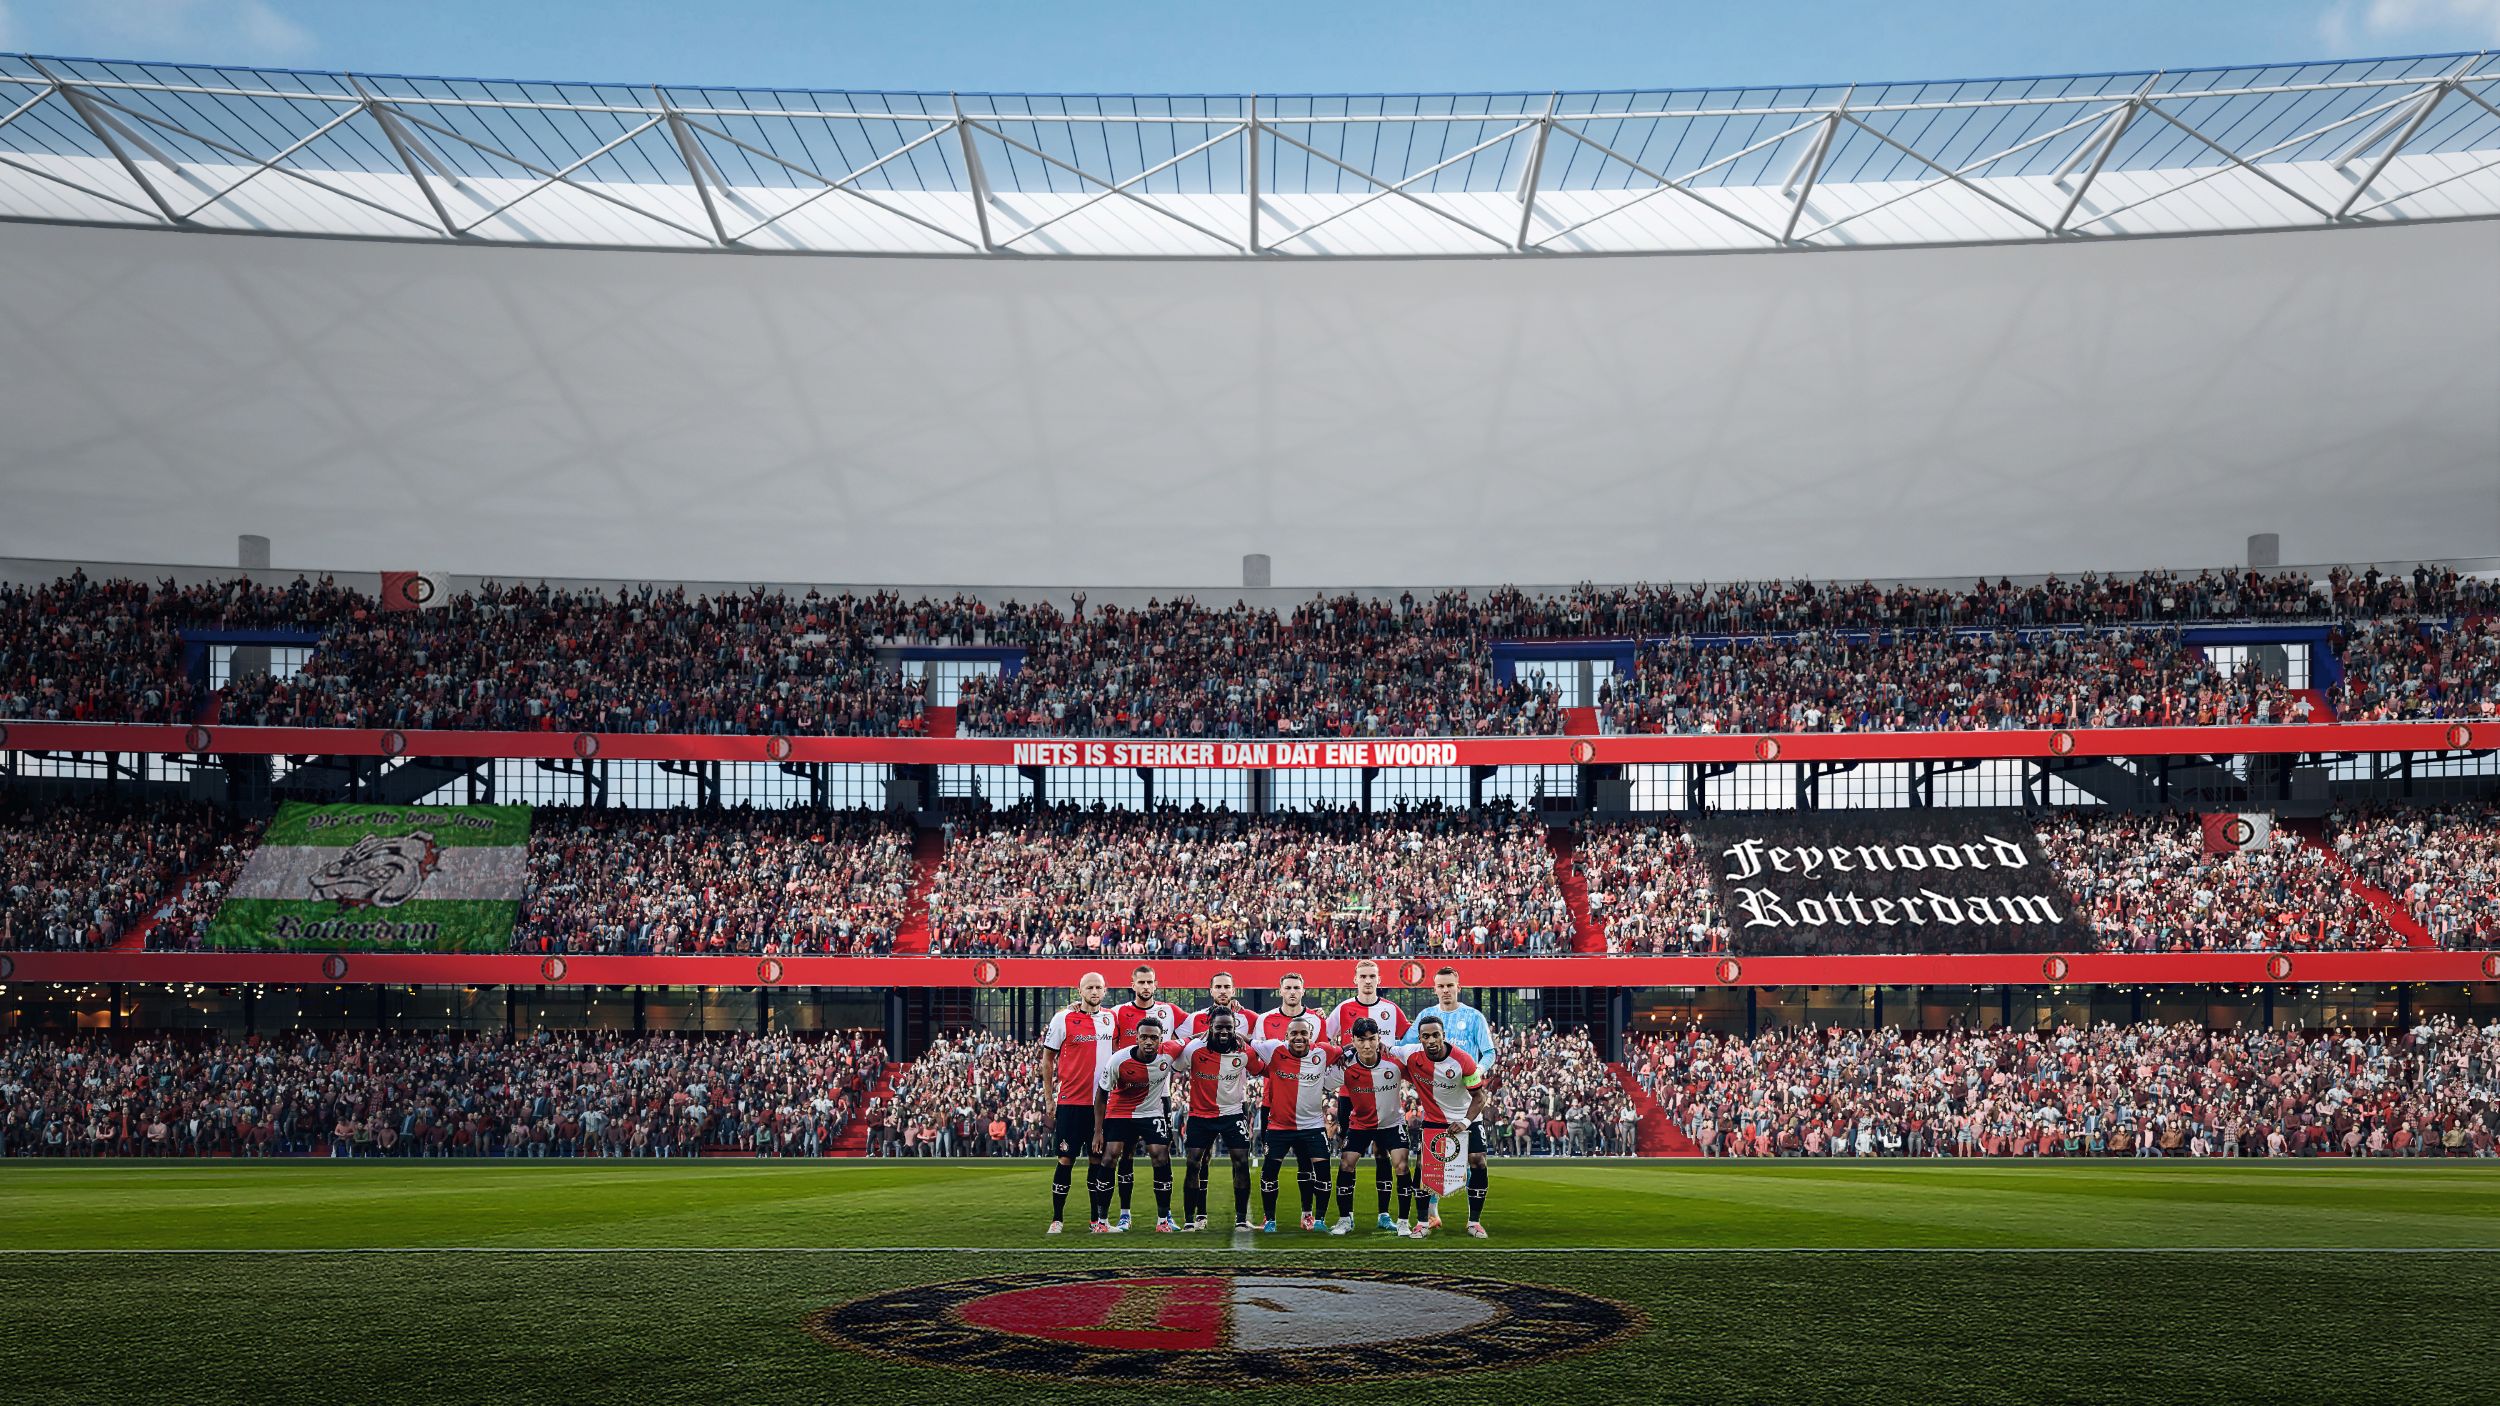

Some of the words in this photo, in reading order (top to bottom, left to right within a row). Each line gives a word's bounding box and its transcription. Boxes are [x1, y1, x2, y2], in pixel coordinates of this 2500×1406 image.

[1013, 744, 1077, 766] NIETS
[1085, 744, 1106, 766] IS
[1114, 744, 1215, 766] STERKER
[1222, 744, 1269, 766] DAN
[1276, 744, 1319, 766] DAT
[1326, 744, 1369, 766] ENE
[1374, 744, 1457, 766] WOORD
[306, 812, 365, 831] We're
[371, 810, 400, 826] the
[452, 812, 496, 830] from
[1723, 834, 2029, 881] Feyenoord
[1733, 886, 2064, 928] Rotterdam
[272, 914, 440, 941] Rotterdam
